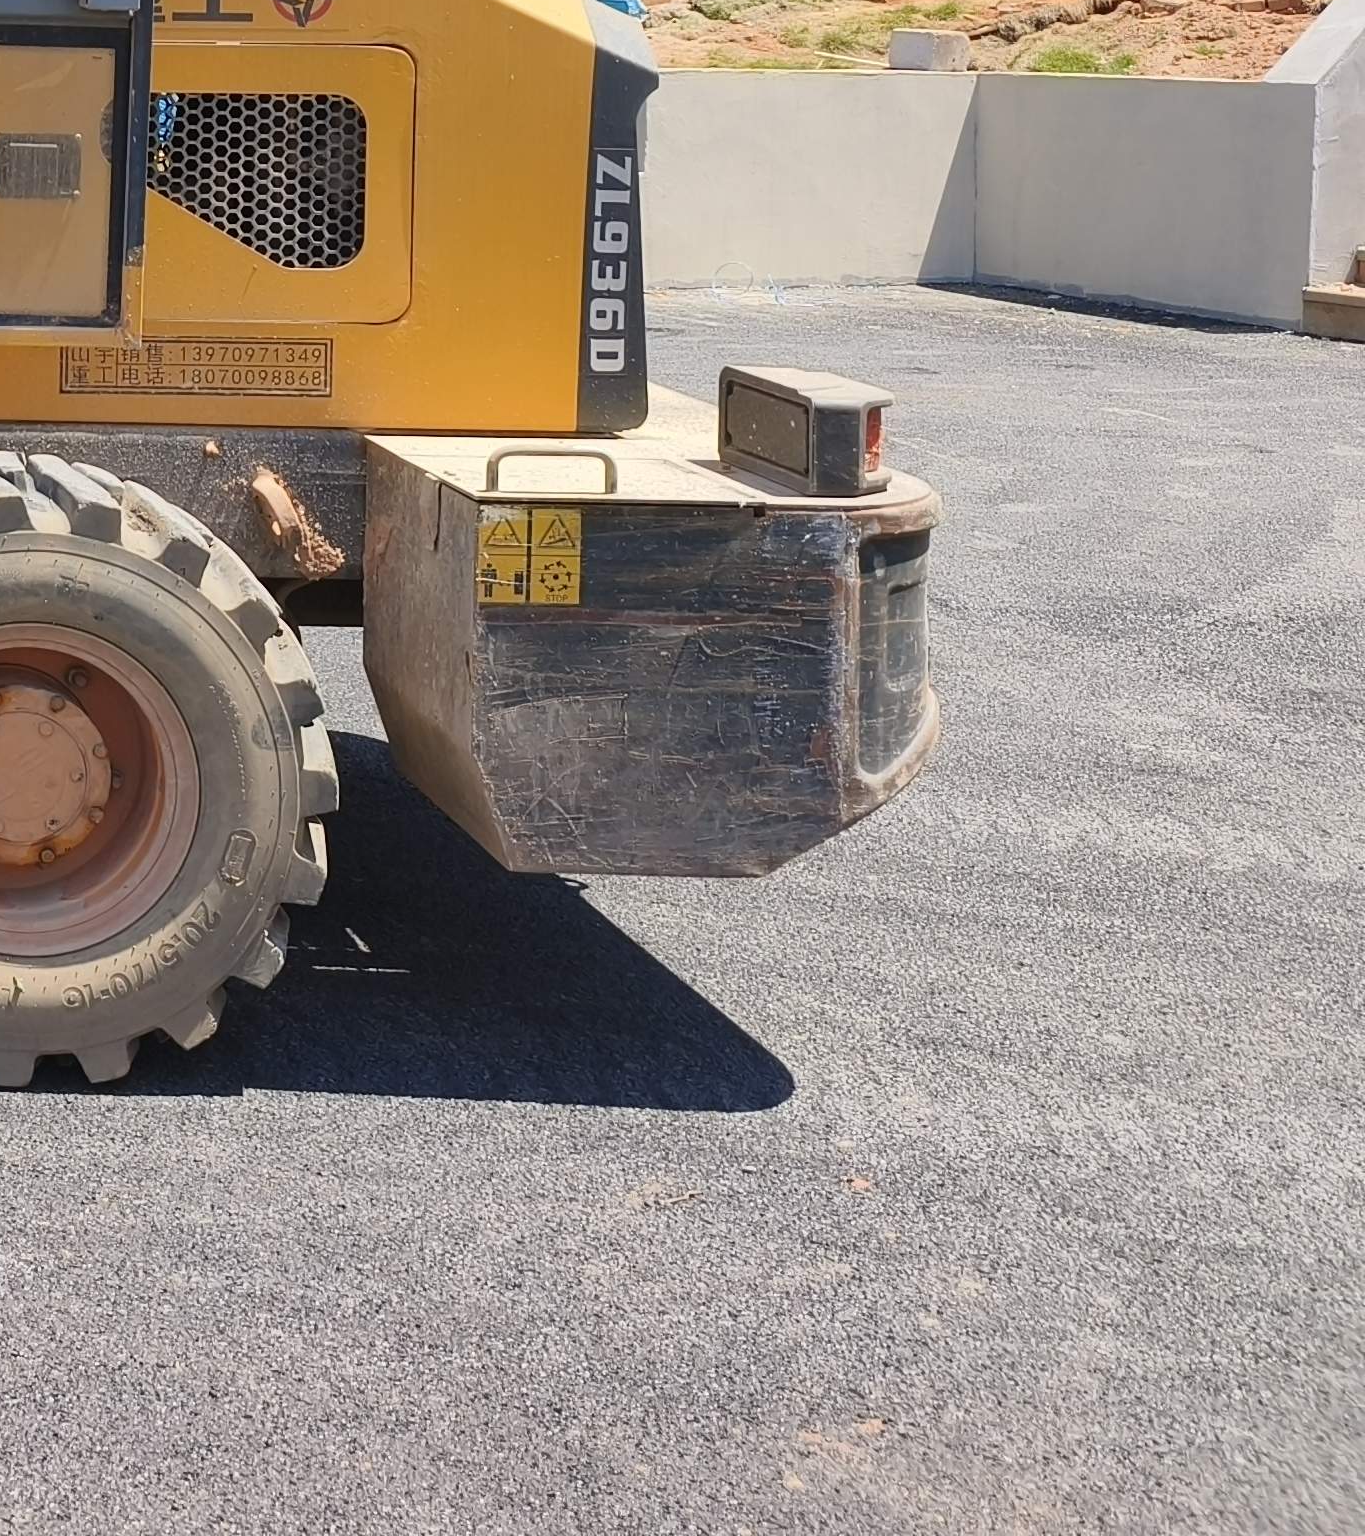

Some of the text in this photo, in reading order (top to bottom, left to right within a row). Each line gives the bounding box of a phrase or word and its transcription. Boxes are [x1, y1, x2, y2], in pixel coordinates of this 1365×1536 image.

[589, 153, 633, 372] ZL936D
[71, 346, 114, 364] 山宇
[69, 365, 114, 384] 重工
[545, 593, 569, 602] STOP
